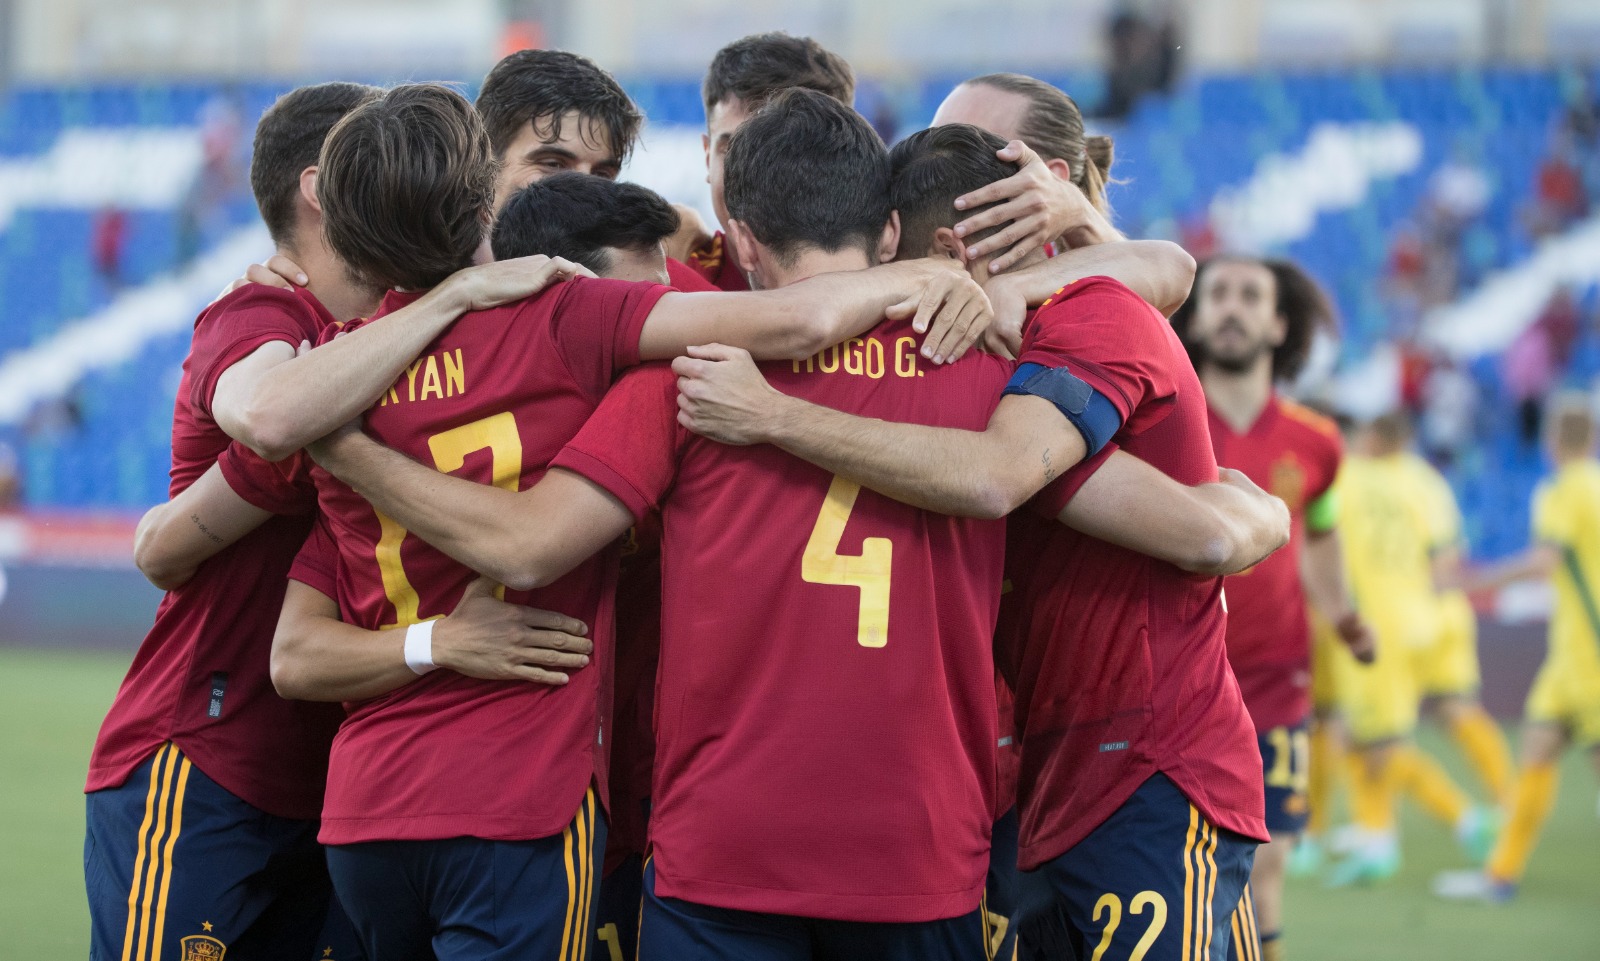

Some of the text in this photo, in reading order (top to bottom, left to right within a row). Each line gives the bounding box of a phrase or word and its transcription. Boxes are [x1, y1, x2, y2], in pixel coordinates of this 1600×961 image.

[895, 336, 924, 378] G.
[802, 474, 893, 648] 4
[1091, 890, 1168, 961] 22
